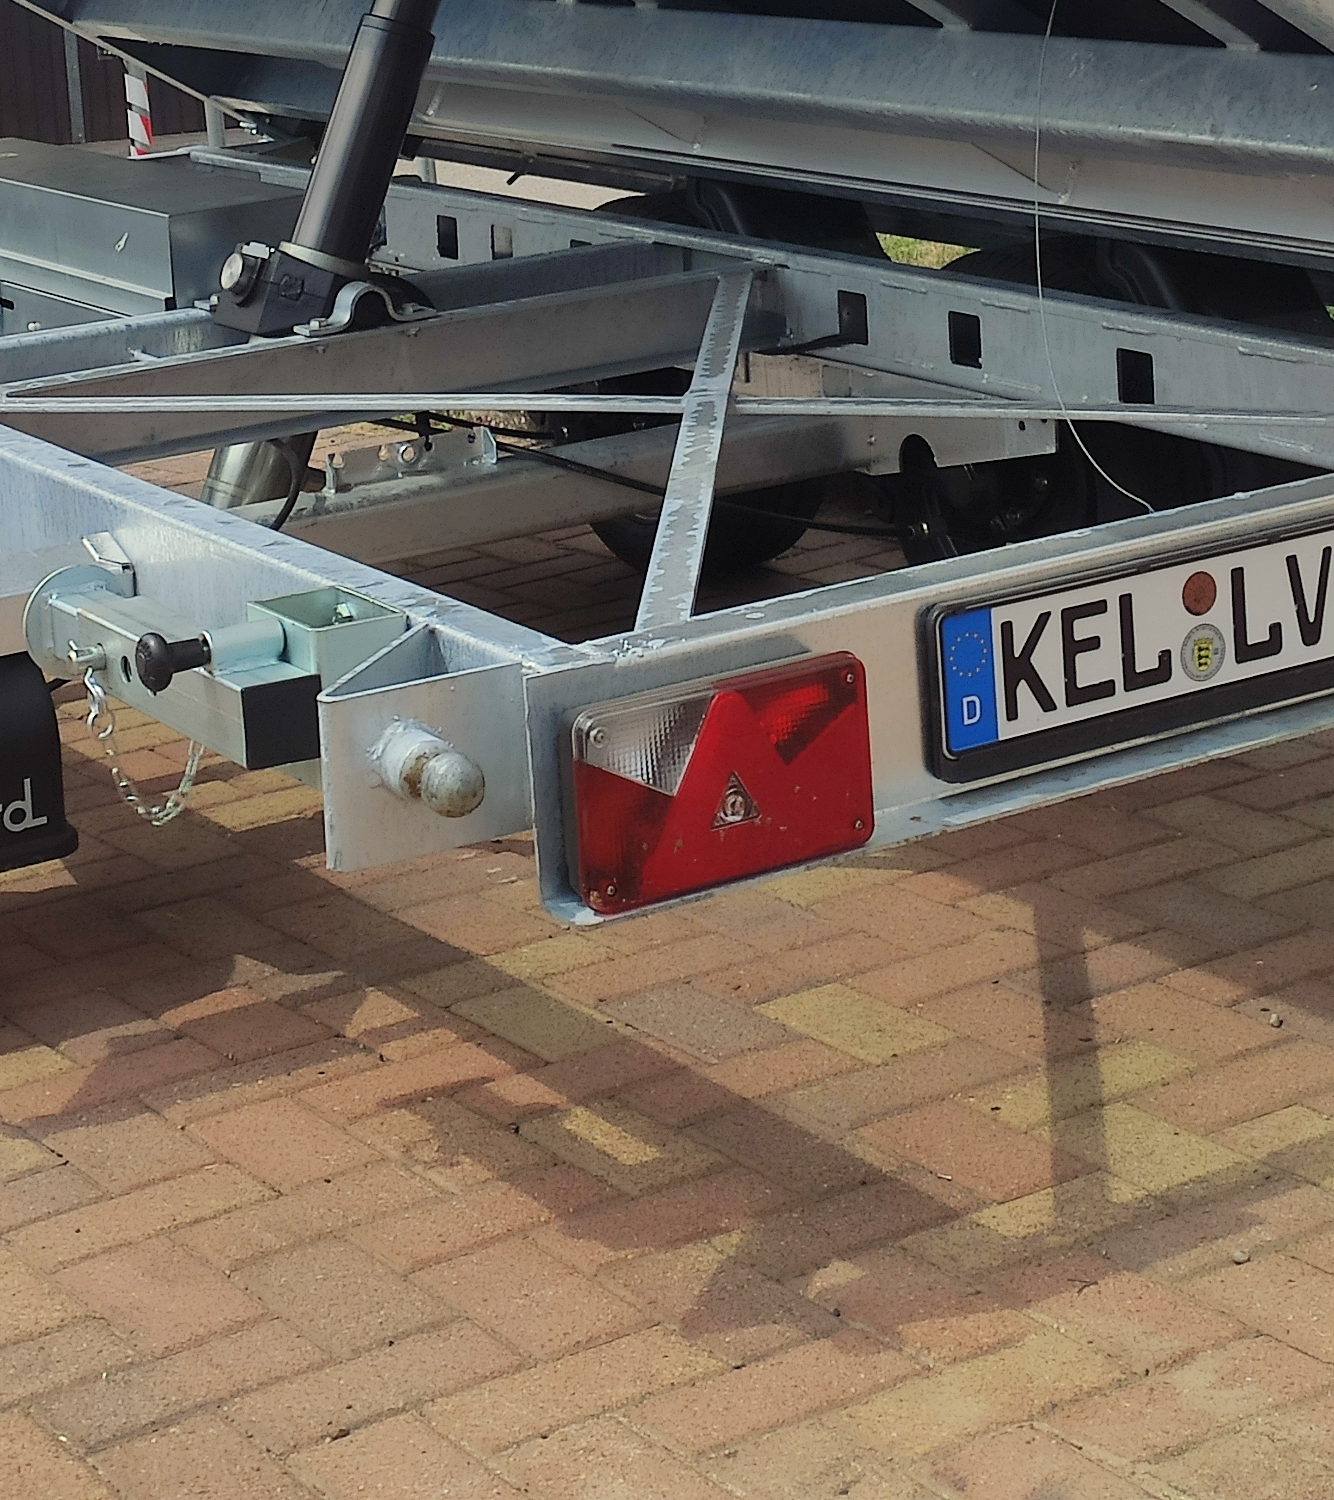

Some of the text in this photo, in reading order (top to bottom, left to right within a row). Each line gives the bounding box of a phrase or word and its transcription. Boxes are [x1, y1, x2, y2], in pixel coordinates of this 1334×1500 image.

[1000, 592, 1173, 724] KEL
[1230, 545, 1333, 665] LV
[961, 694, 982, 726] D
